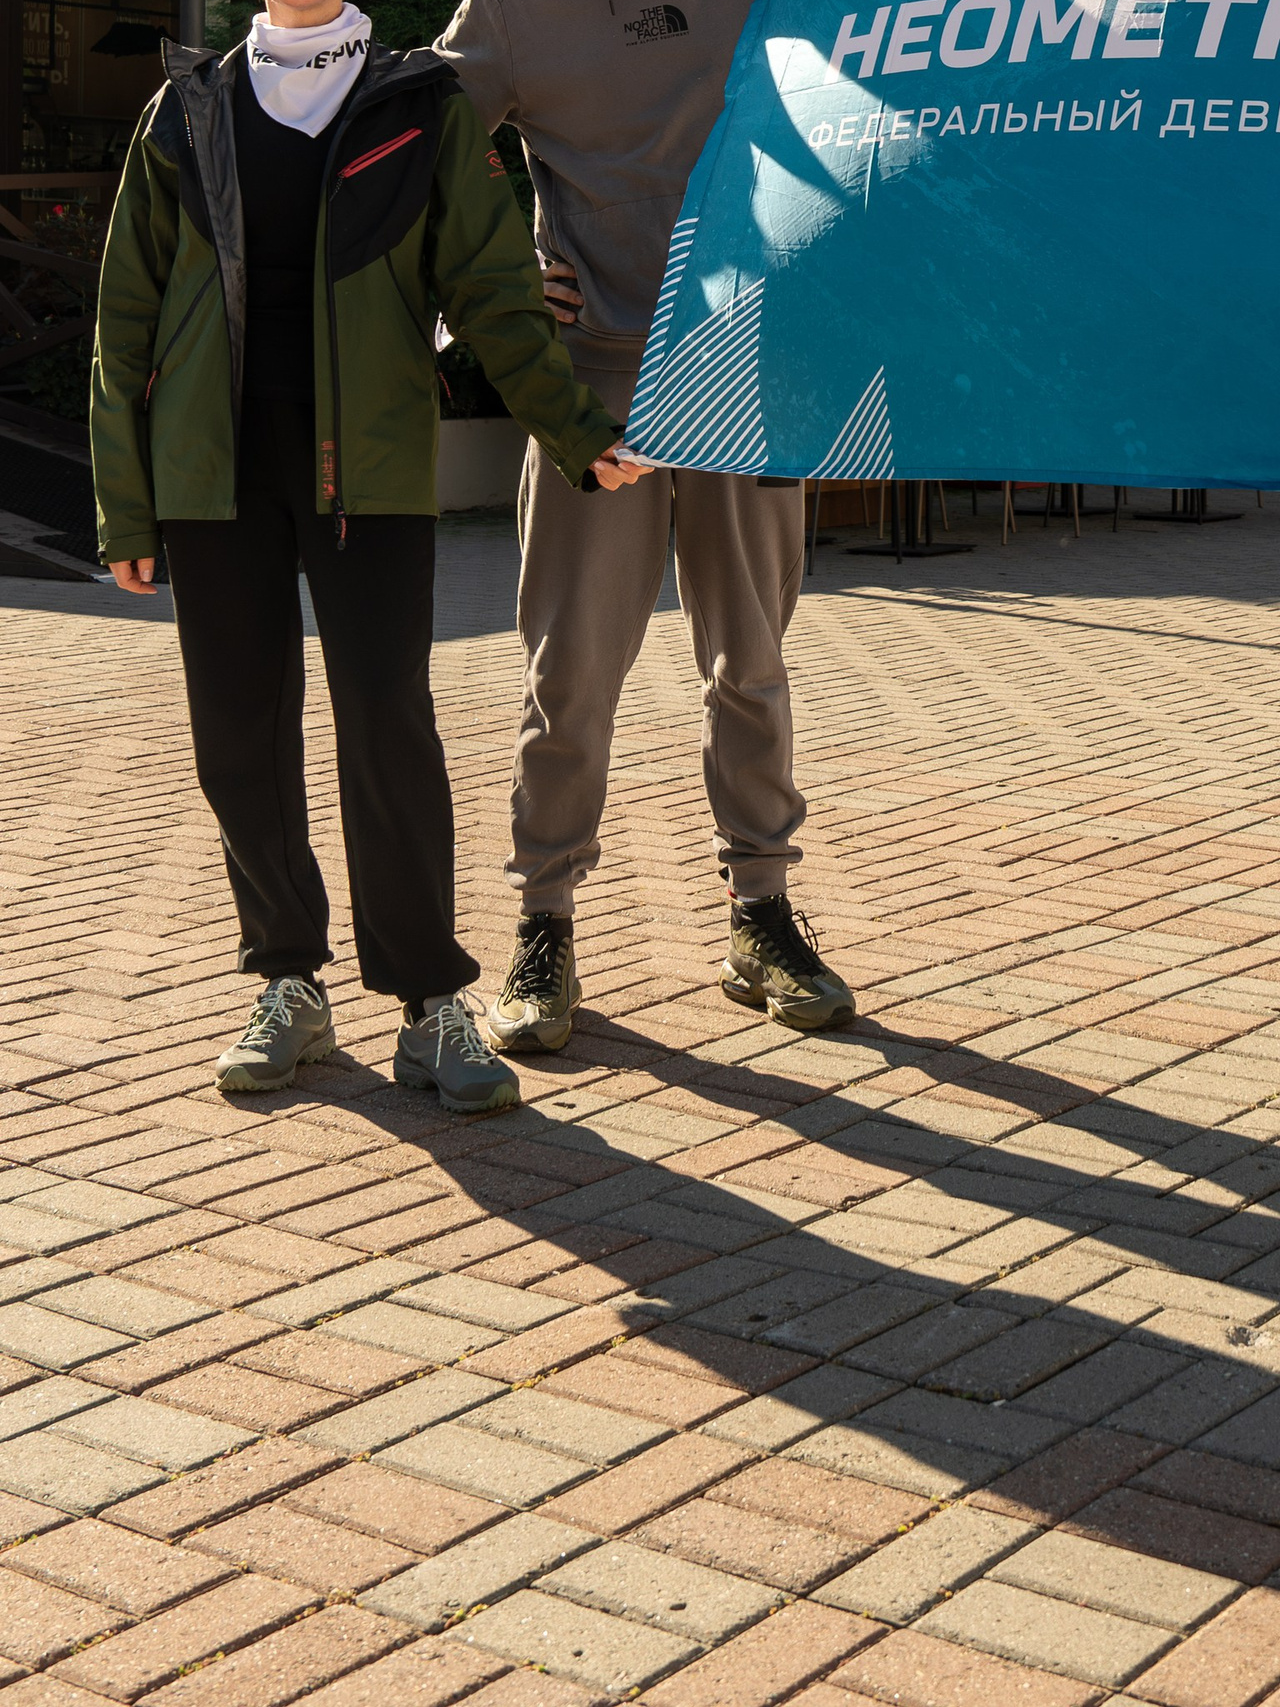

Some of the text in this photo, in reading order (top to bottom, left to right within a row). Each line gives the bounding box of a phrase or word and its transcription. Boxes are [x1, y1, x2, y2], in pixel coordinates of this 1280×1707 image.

[640, 5, 663, 19] THE
[624, 15, 666, 33] NORTH
[637, 25, 667, 40] FACE
[807, 89, 1143, 152] ФЕДЕРАЛЬНЫЙ
